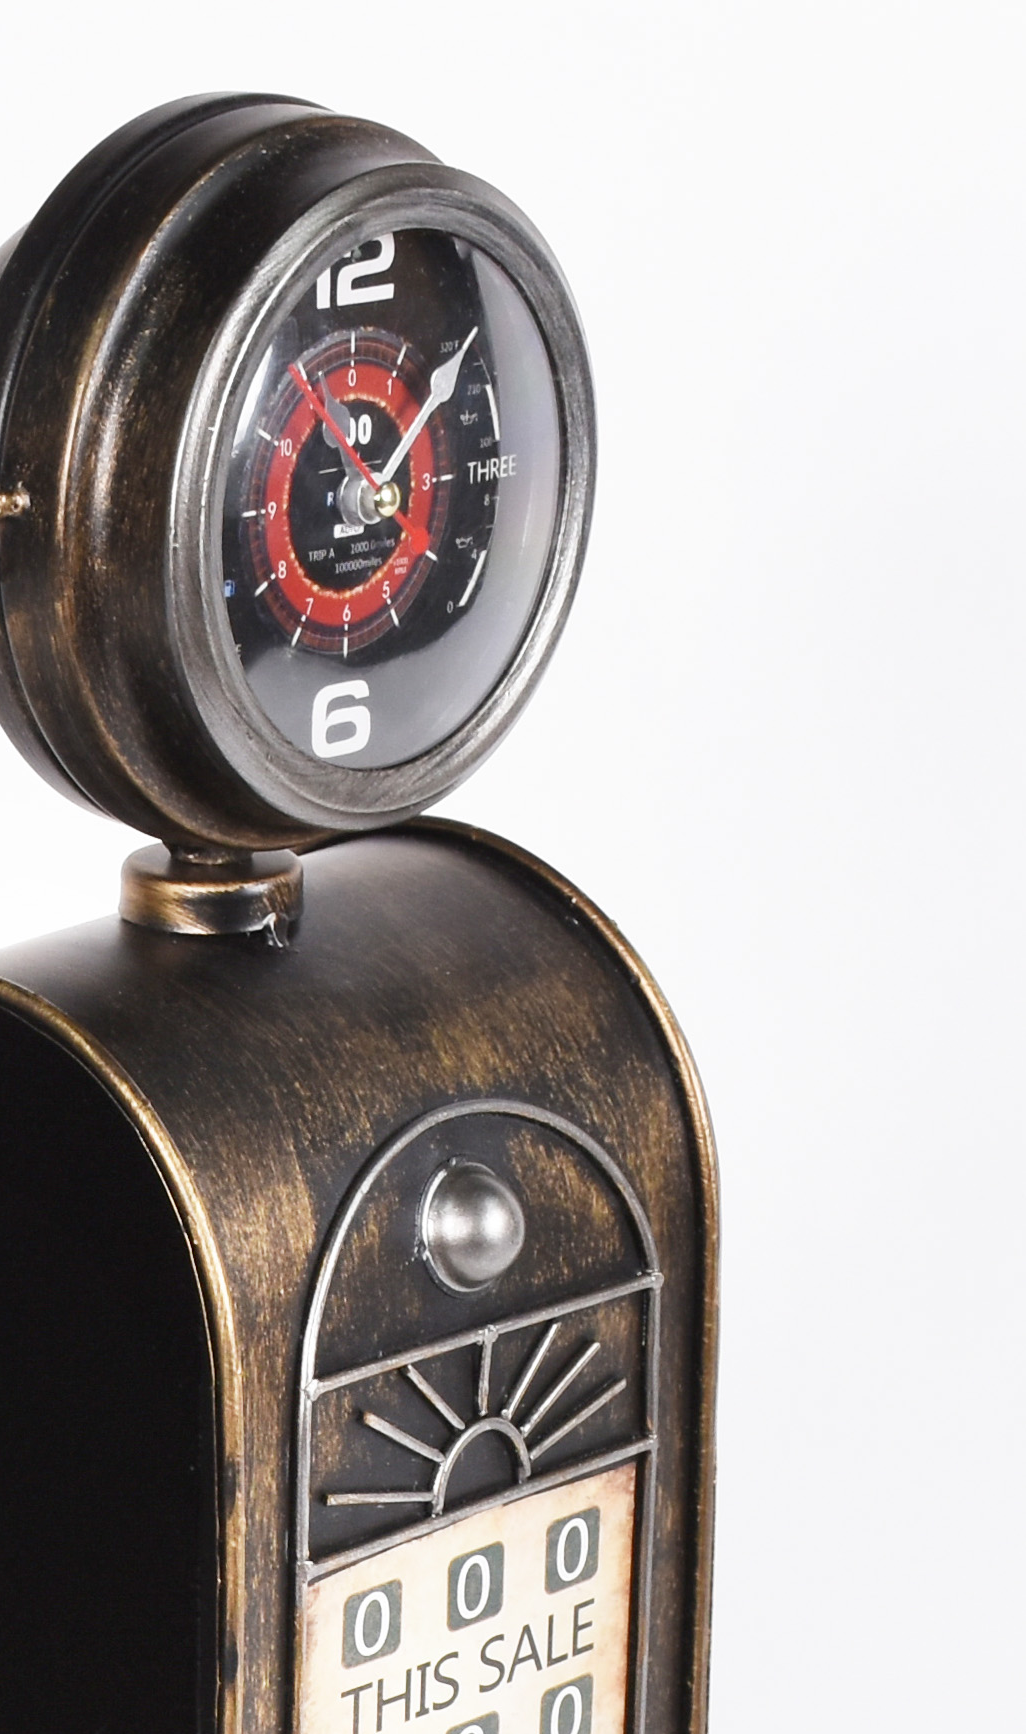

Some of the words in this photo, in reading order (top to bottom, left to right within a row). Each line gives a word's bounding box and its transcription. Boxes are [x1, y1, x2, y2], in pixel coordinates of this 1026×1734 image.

[316, 232, 395, 310] 12
[348, 369, 356, 387] 0
[386, 378, 393, 396] 1
[280, 438, 293, 457] 10
[467, 454, 517, 485] THREE
[422, 473, 431, 491] 3
[267, 502, 277, 520] 9
[308, 549, 327, 562] TRIP
[328, 547, 335, 559] A
[278, 560, 287, 579] 8
[382, 580, 390, 599] 5
[305, 597, 314, 616] 7
[342, 603, 351, 622] 6
[446, 601, 453, 613] 0
[311, 679, 371, 759] 6
[354, 1590, 391, 1657] 0
[457, 1554, 491, 1620] 0
[555, 1518, 589, 1583] 0
[480, 1599, 595, 1694] SALE
